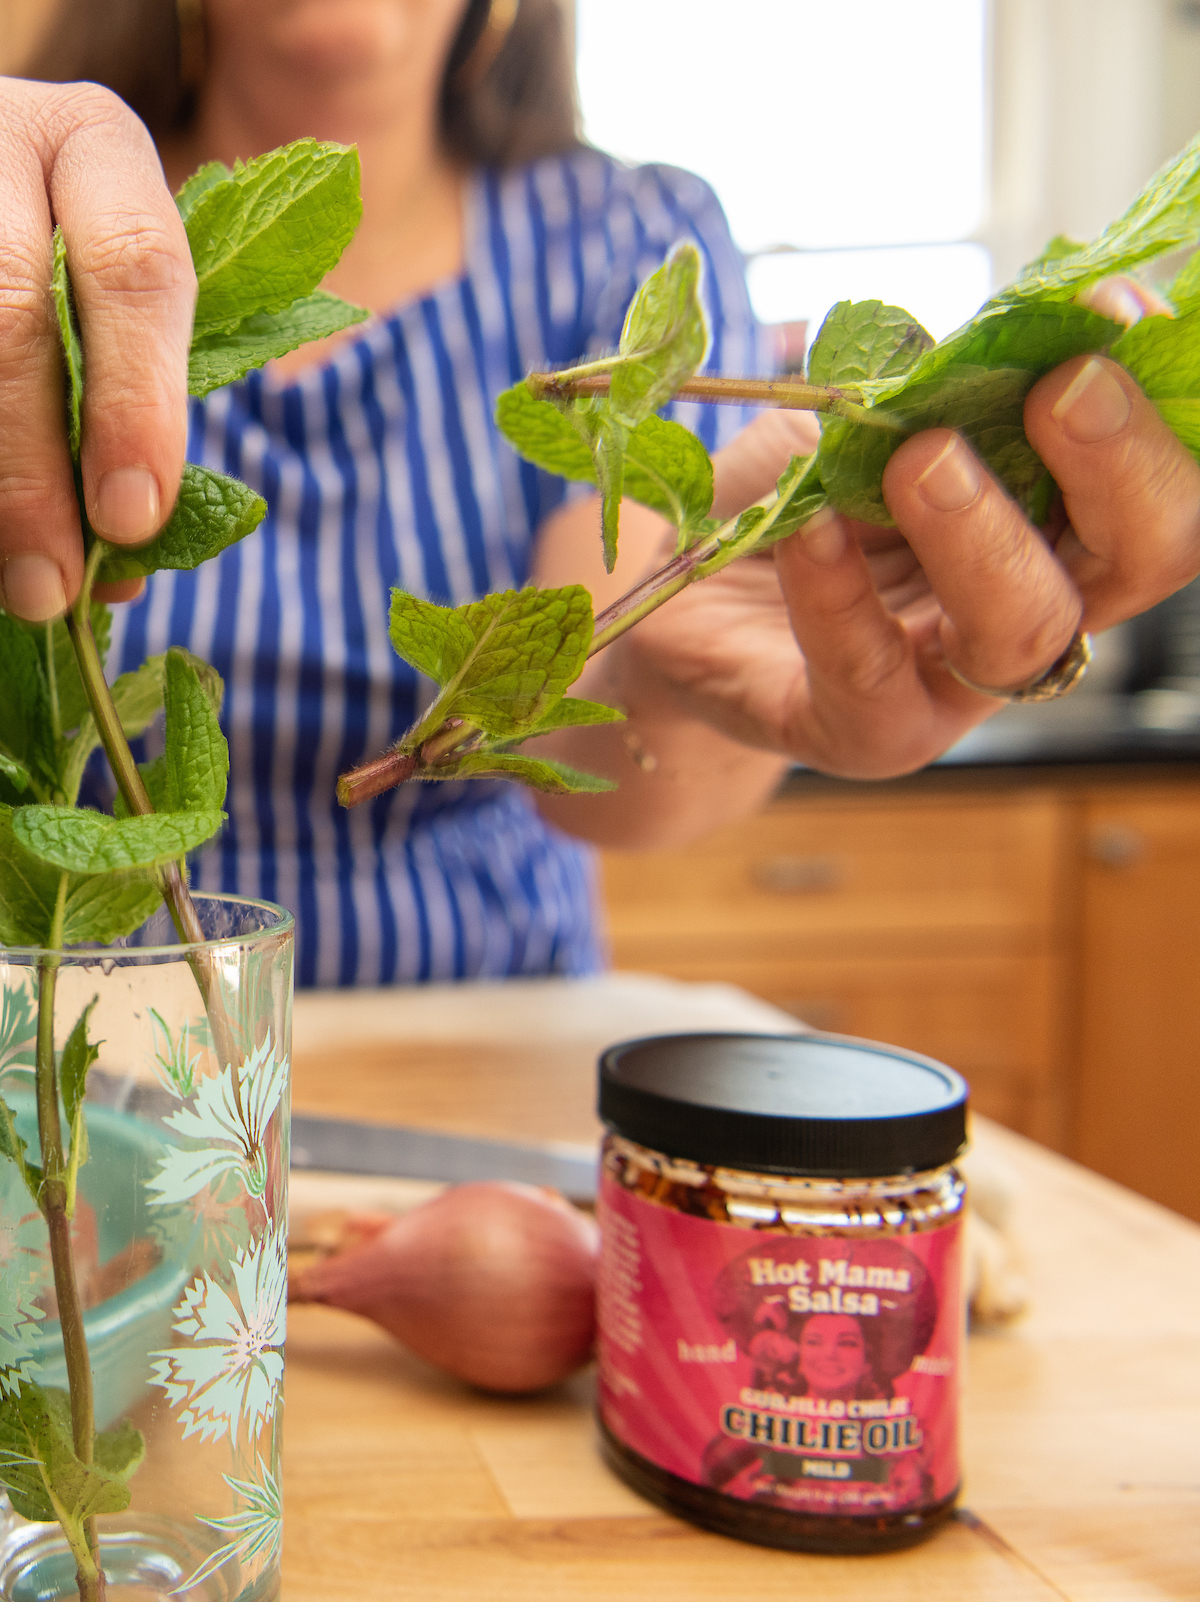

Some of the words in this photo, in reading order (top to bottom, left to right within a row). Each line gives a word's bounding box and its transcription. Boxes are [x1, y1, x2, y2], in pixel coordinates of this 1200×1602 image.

[749, 1258, 812, 1286] Hot
[818, 1259, 911, 1292] Mama
[787, 1286, 880, 1316] Salsa
[722, 1405, 860, 1453] CHILIE
[864, 1417, 921, 1453] OIL
